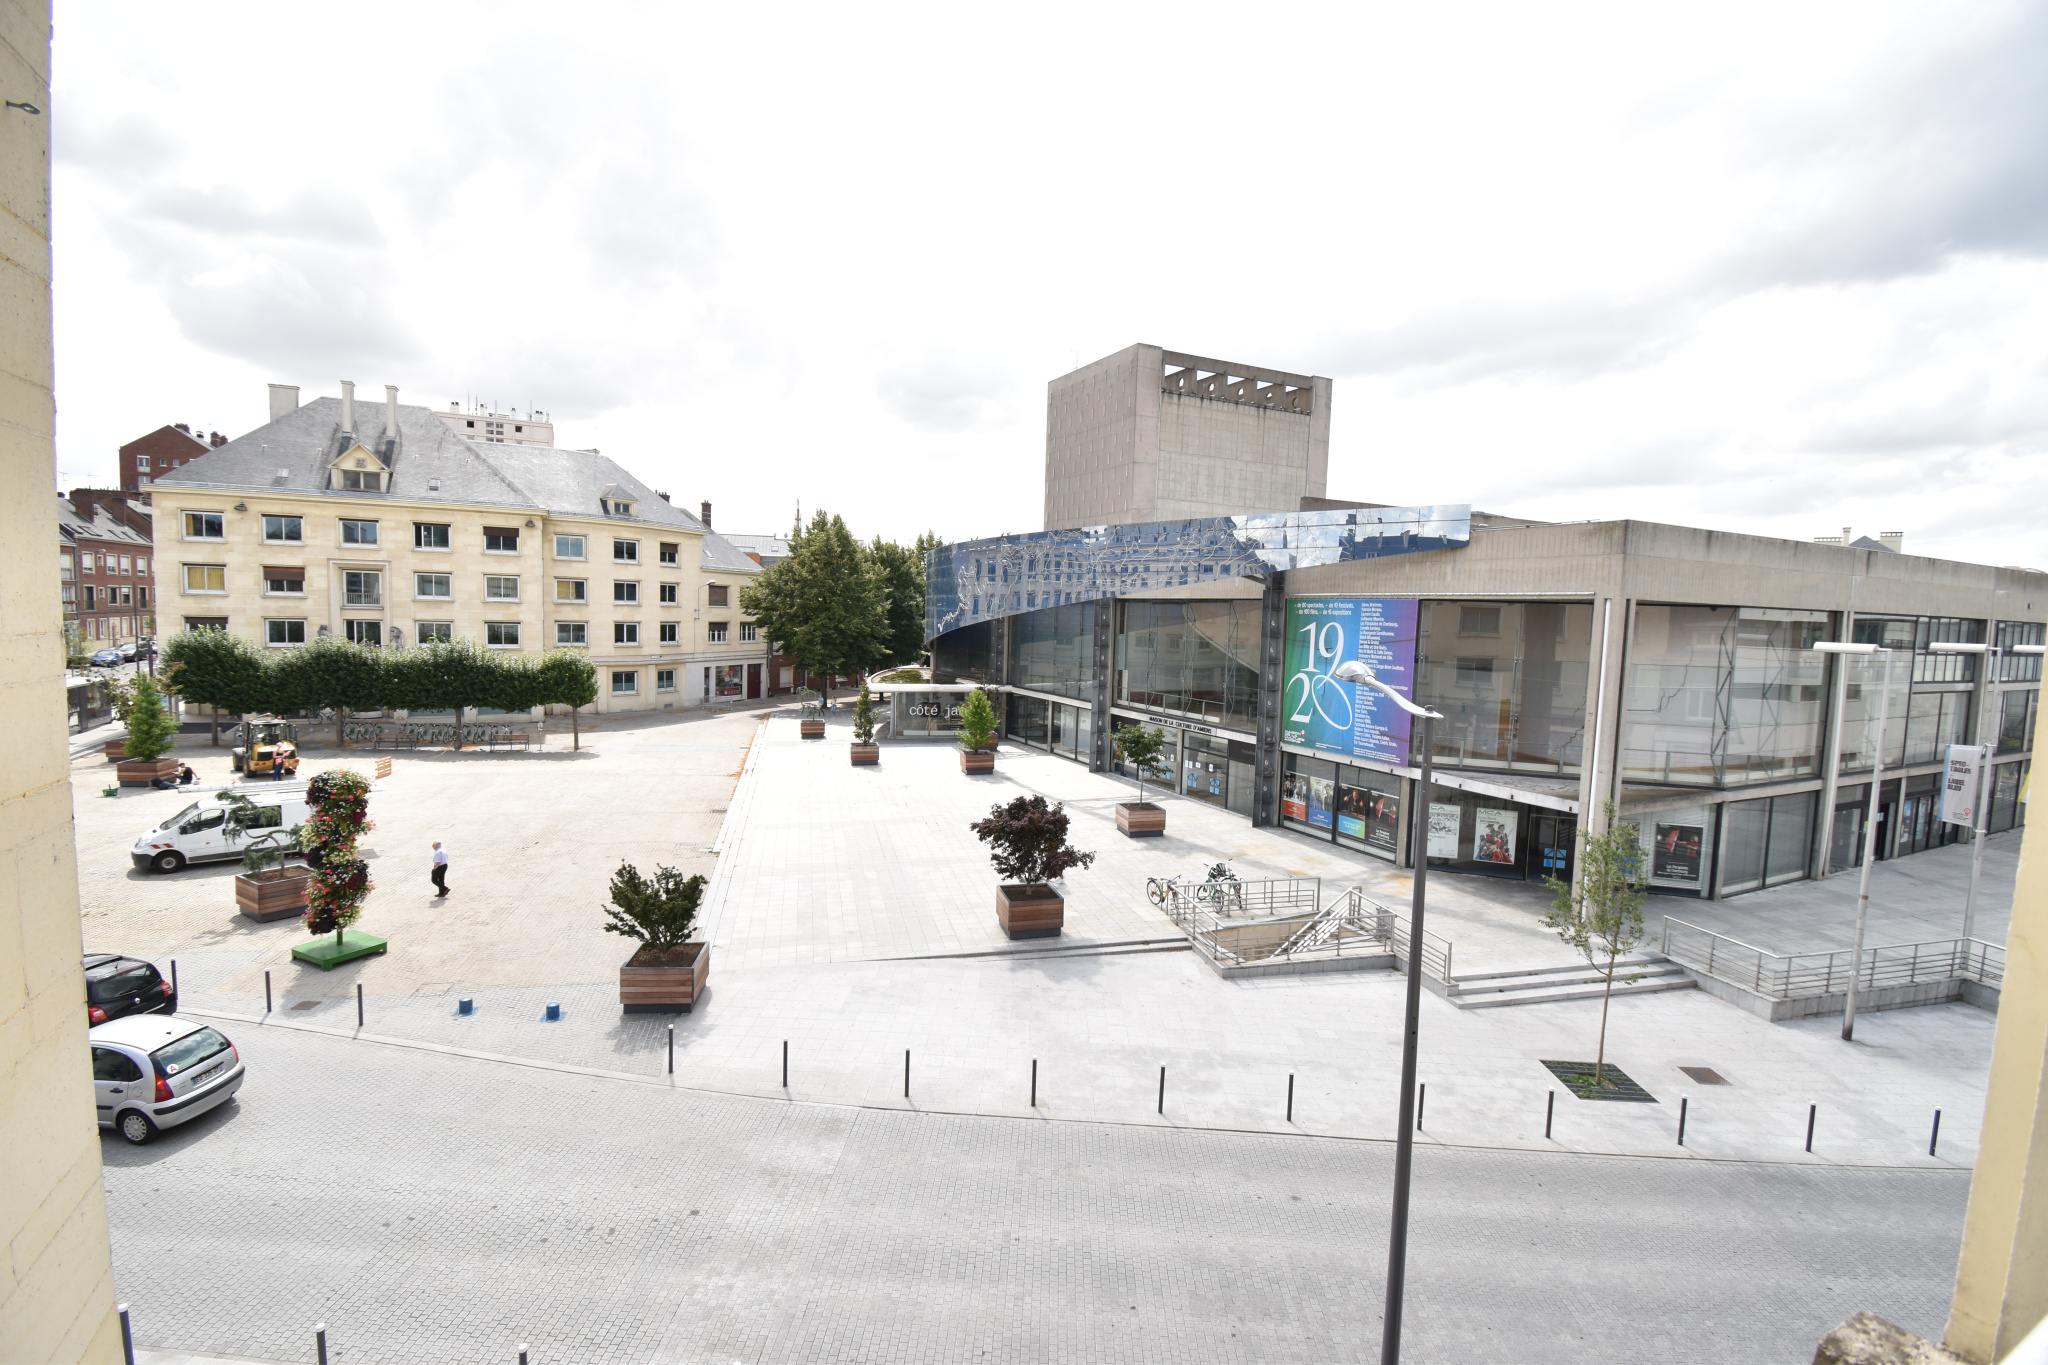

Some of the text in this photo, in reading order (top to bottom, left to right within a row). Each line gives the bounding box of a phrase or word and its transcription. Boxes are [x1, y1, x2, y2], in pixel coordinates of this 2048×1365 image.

[1300, 622, 1344, 689] 19
[1286, 673, 1352, 730] 20
[909, 704, 938, 715] côté
[1193, 725, 1212, 734] D'AMIENS
[1948, 778, 1965, 786] LABEL
